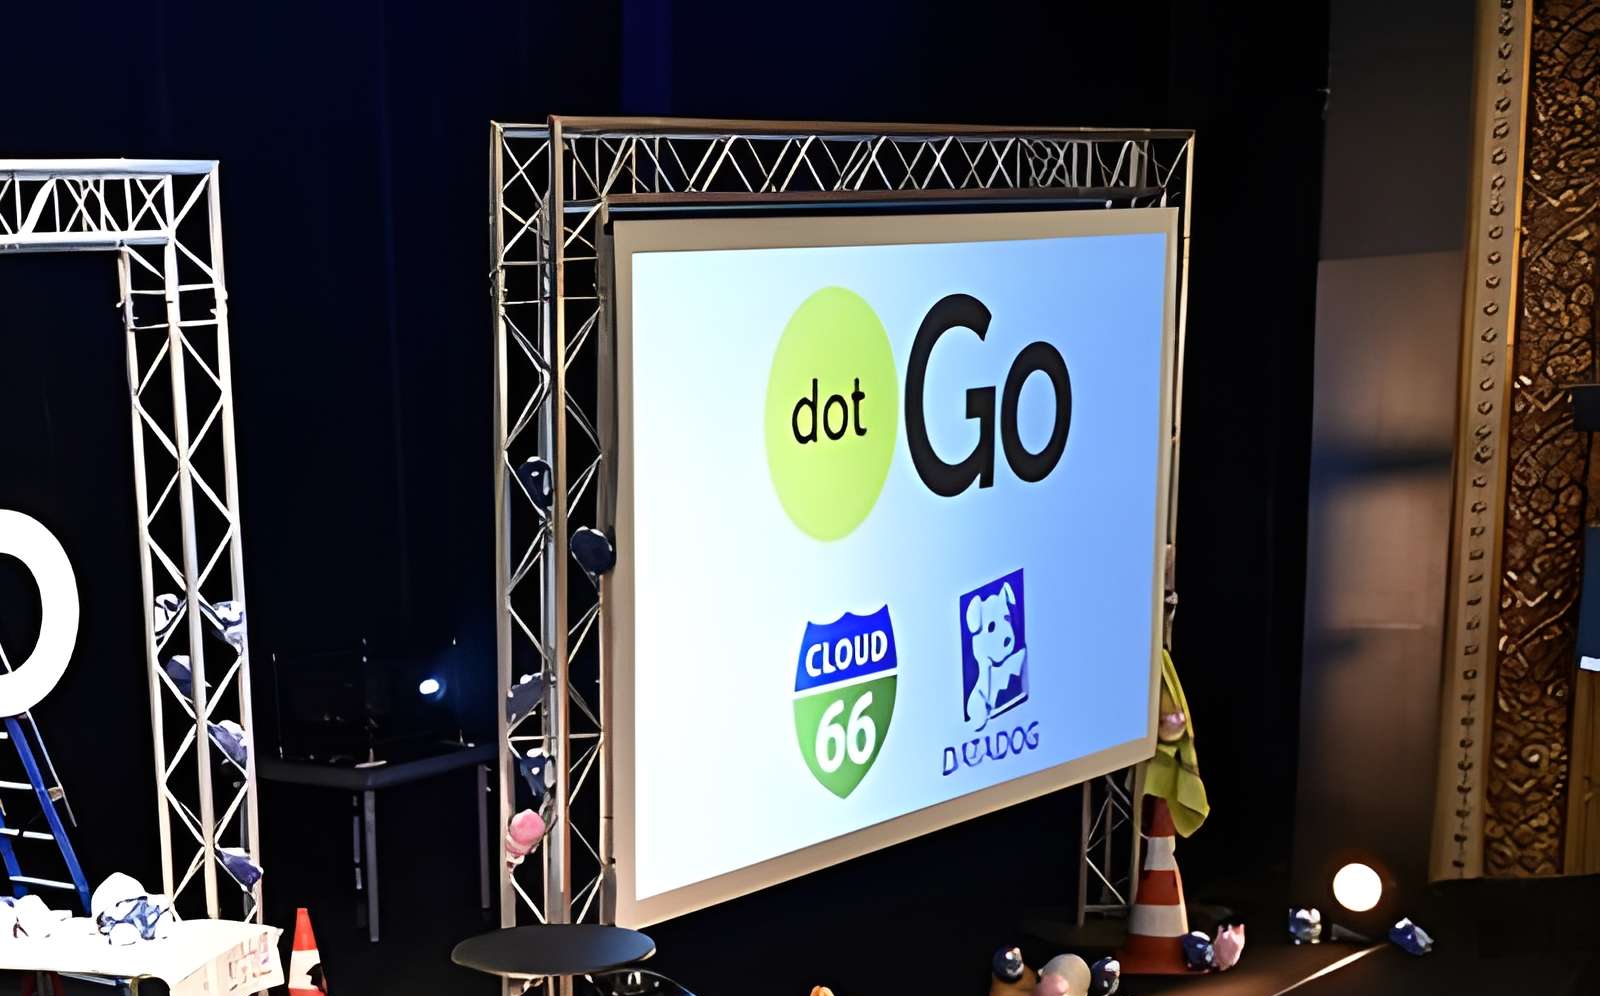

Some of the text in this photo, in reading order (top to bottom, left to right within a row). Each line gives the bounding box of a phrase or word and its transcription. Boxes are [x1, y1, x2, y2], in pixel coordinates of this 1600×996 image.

[791, 293, 1073, 498] dot Go
[805, 630, 889, 678] CLOUD
[815, 690, 877, 774] 66
